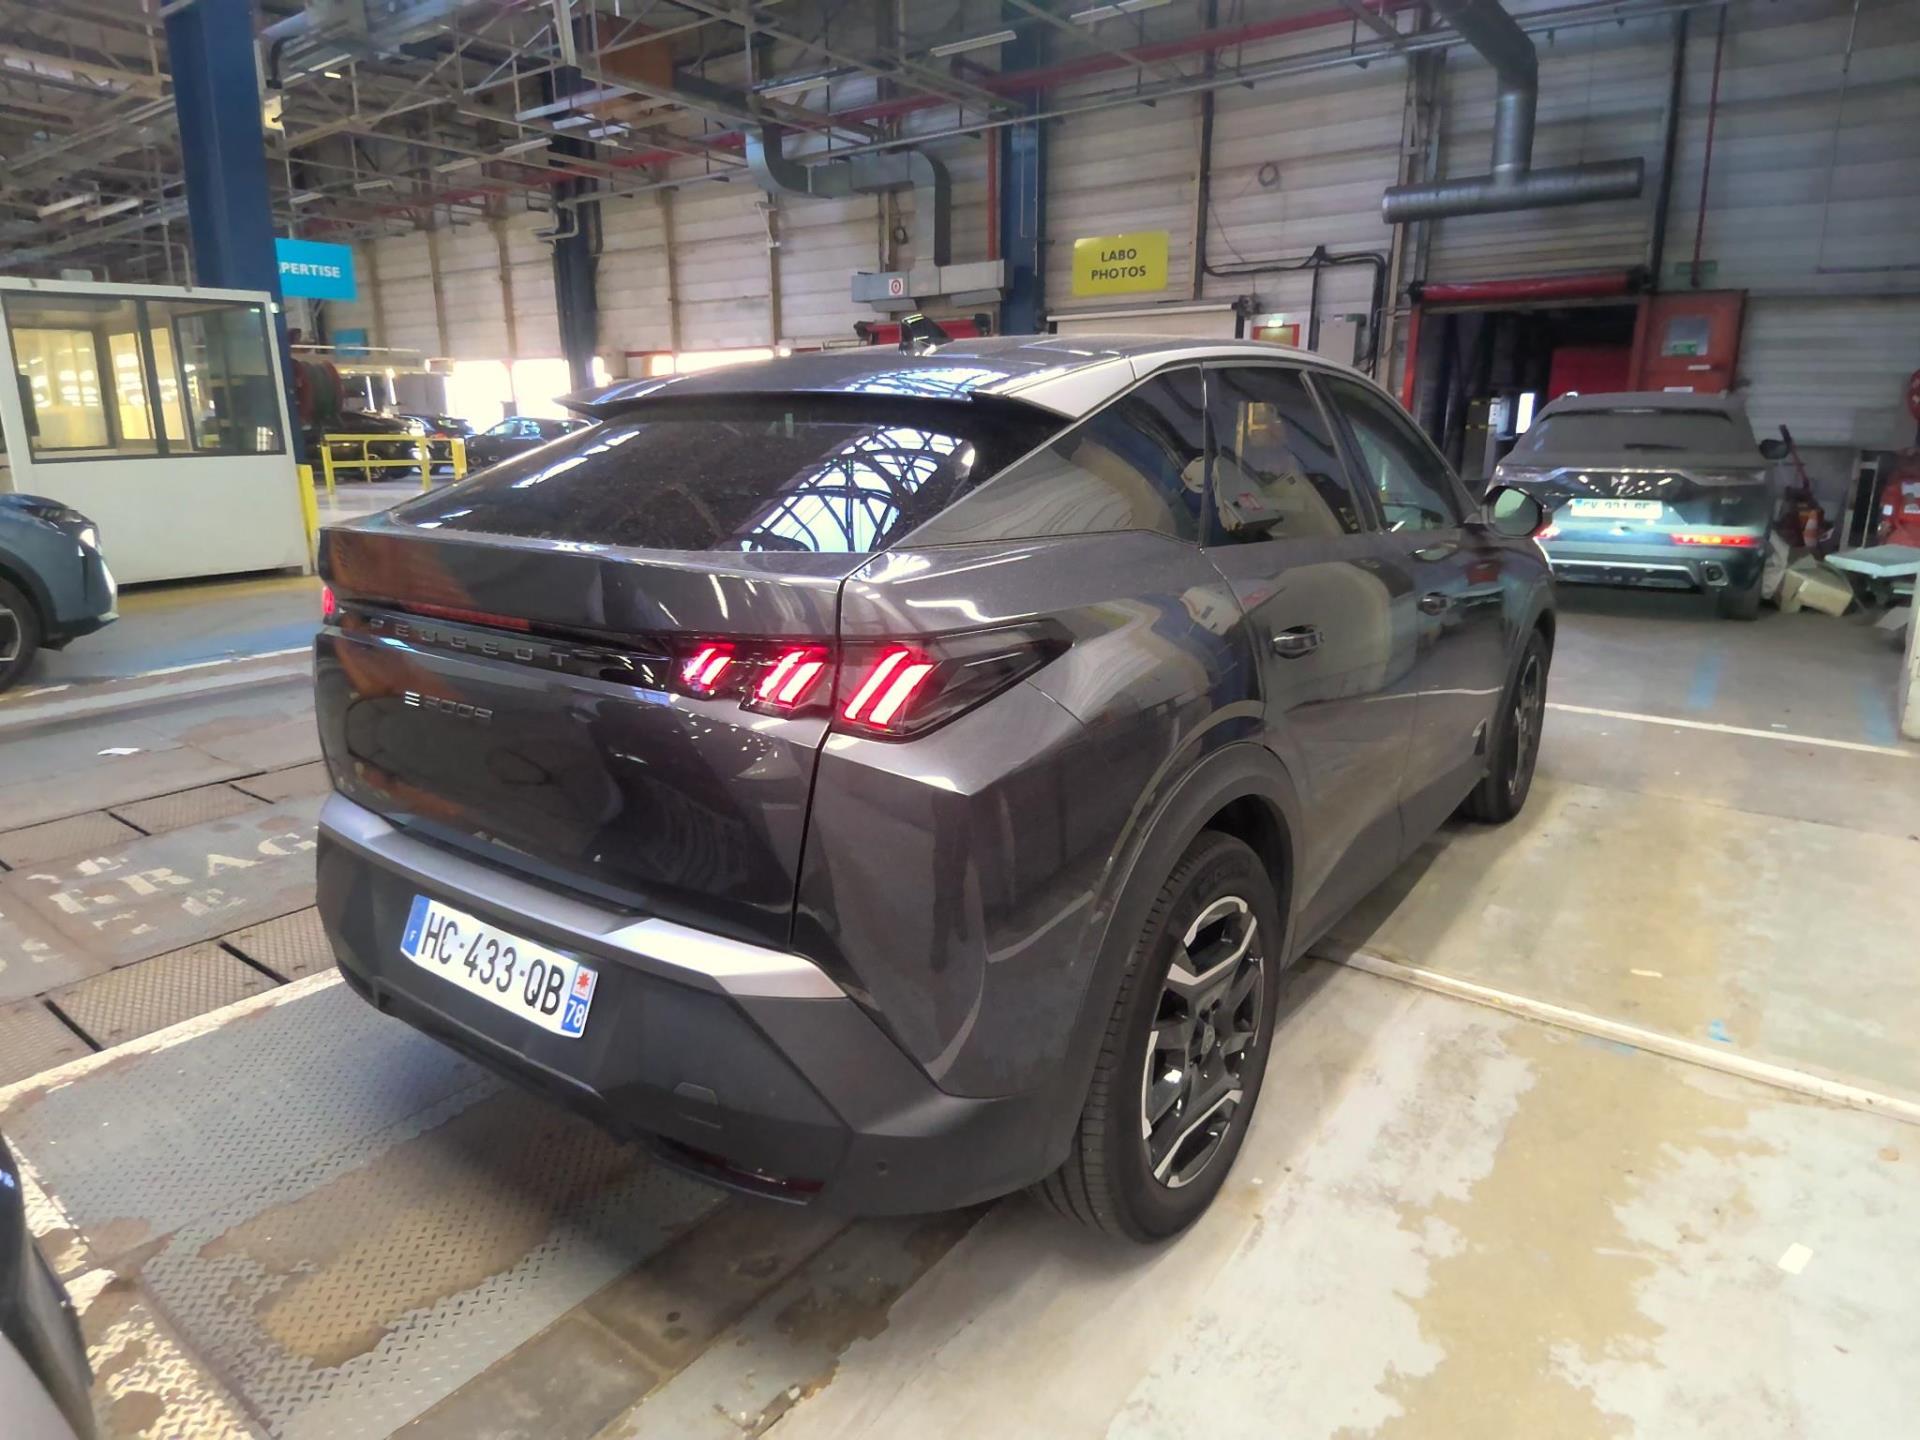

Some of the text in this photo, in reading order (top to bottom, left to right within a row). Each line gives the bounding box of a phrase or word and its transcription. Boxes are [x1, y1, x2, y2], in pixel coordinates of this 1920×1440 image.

[1101, 248, 1137, 262] LABO
[278, 261, 341, 278] PERTISE
[1091, 265, 1146, 280] PHOTOS
[369, 617, 570, 667] PEUGEOT
[421, 911, 565, 1015] HC-433-QB
[564, 999, 585, 1028] 78
